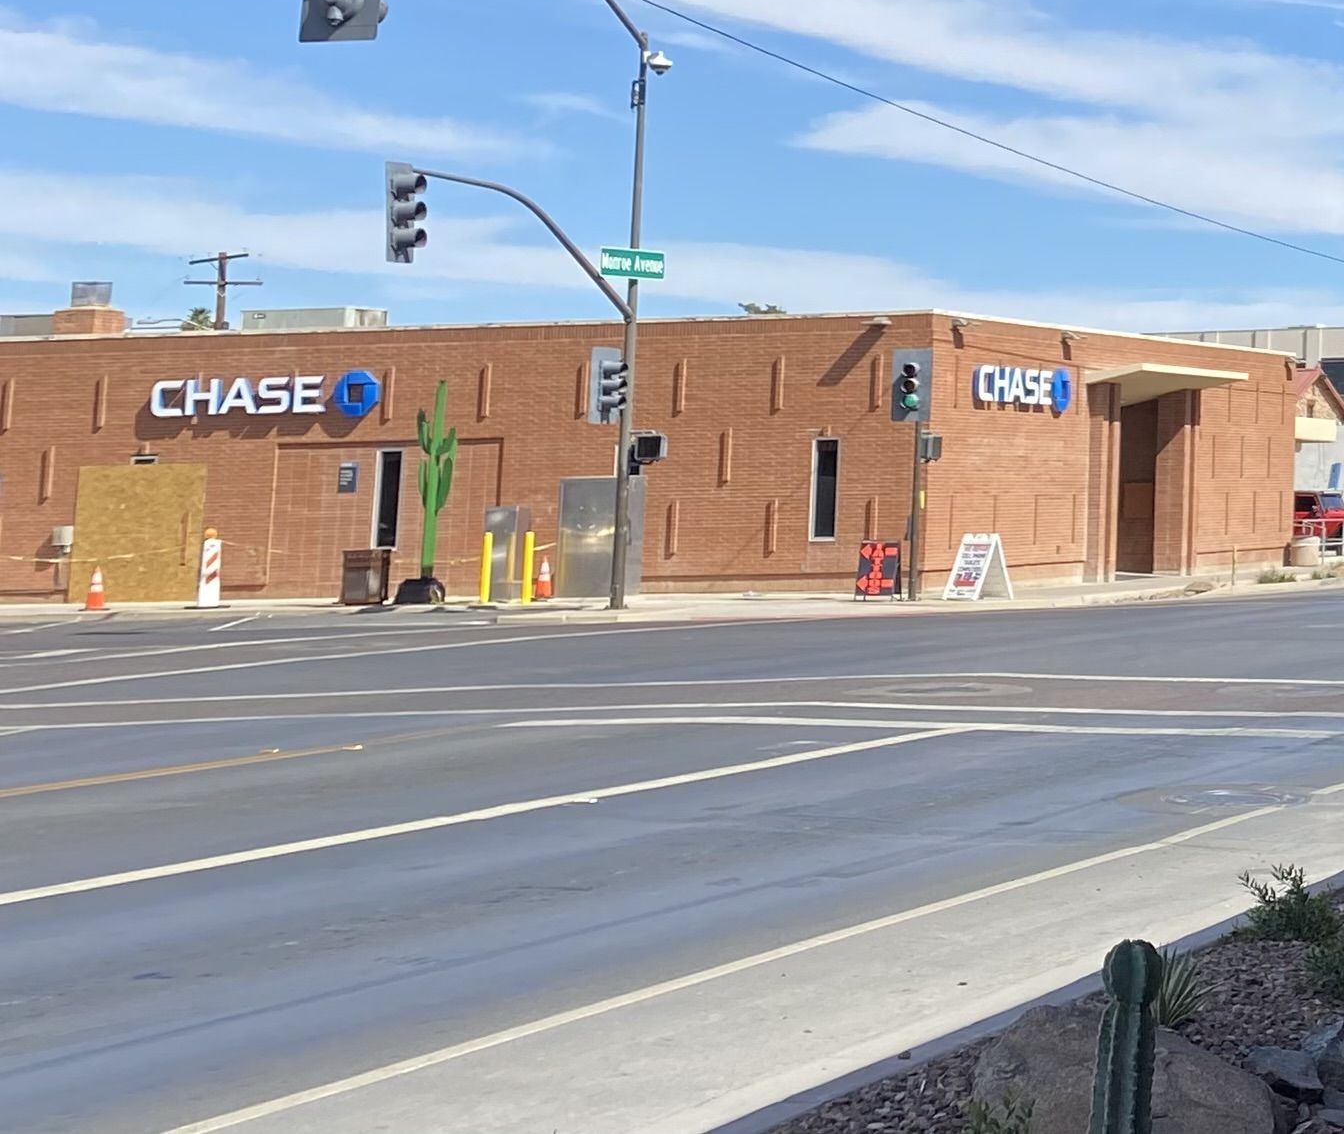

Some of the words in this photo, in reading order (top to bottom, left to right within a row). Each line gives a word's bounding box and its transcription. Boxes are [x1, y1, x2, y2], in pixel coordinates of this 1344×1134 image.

[602, 252, 632, 272] Monroe
[634, 255, 663, 274] Avenue
[150, 375, 327, 419] CHASE
[978, 364, 1053, 407] CHASE
